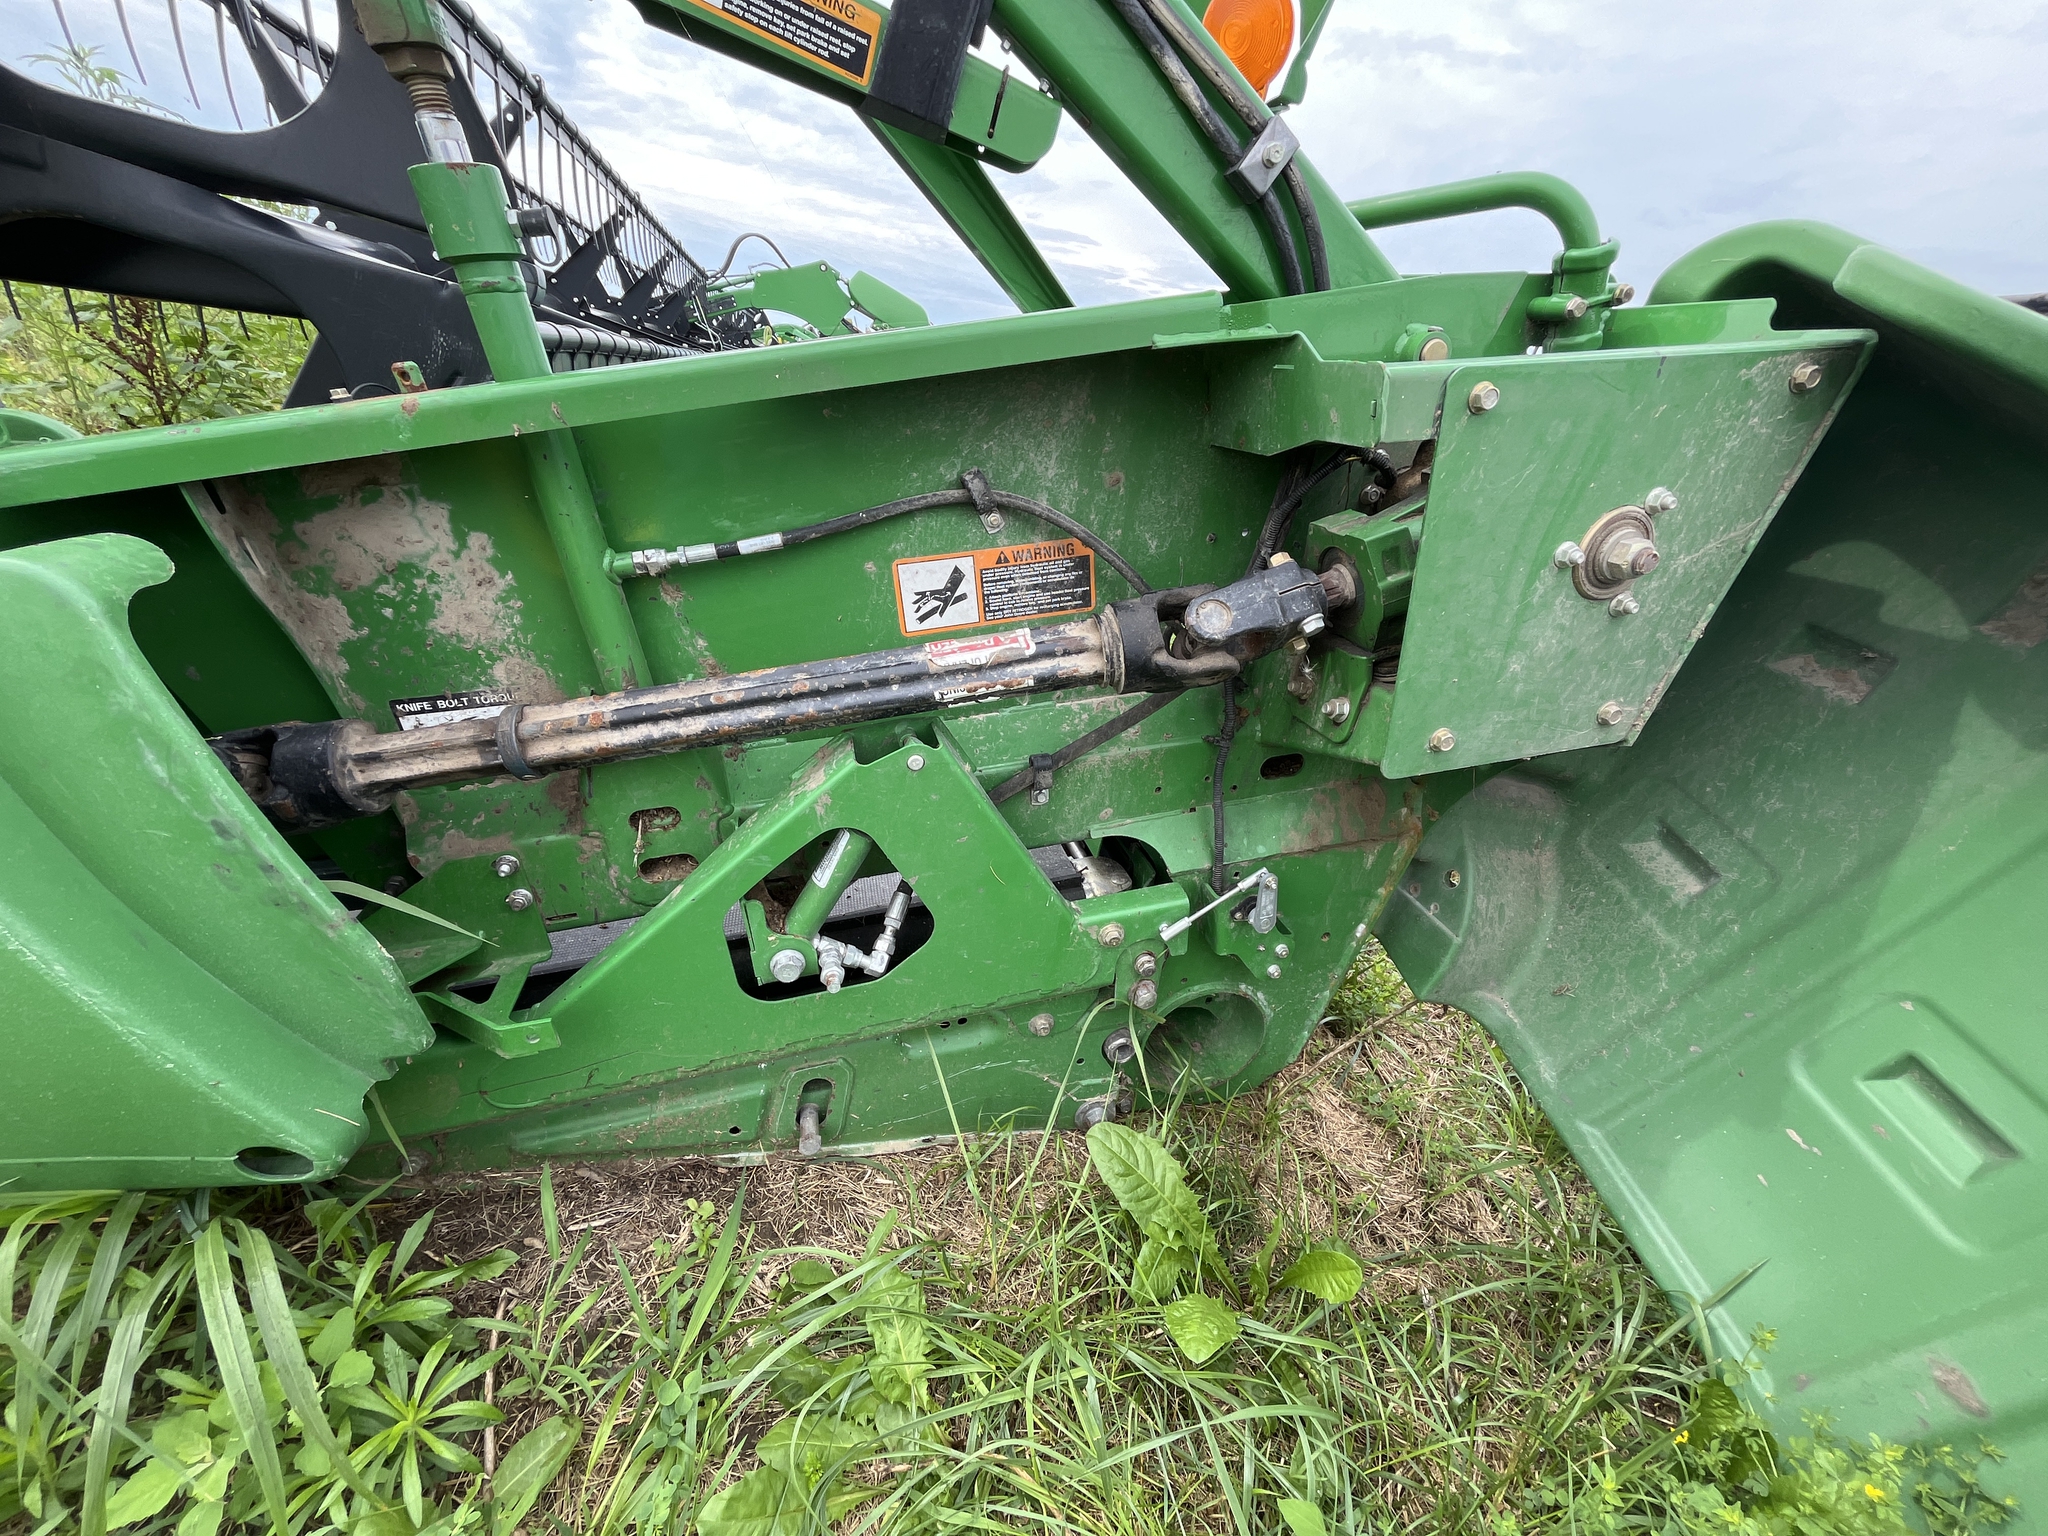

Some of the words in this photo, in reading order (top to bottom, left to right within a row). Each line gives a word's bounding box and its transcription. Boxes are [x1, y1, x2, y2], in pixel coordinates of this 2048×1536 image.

[724, 2, 743, 16] safety
[744, 12, 758, 22] stop
[768, 24, 783, 35] each
[784, 30, 792, 39] lift
[793, 36, 817, 51] cylinder
[817, 48, 829, 57] rod.
[749, 5, 772, 20] remove
[786, 23, 795, 32] set
[796, 28, 810, 39] park
[810, 34, 827, 47] brake
[828, 44, 839, 53] and
[840, 50, 849, 58] set
[774, 8, 782, 16] on
[791, 16, 809, 29] under
[809, 26, 828, 39] raised
[829, 35, 841, 46] reel,
[842, 42, 855, 52] stop
[799, 6, 814, 18] from
[814, 14, 824, 24] fall
[837, 26, 855, 39] raised
[855, 35, 867, 45] reel.
[1012, 543, 1074, 562] WARNING
[396, 701, 433, 712] KNIFE
[436, 698, 468, 709] BOLT
[473, 692, 518, 704] TORQU
